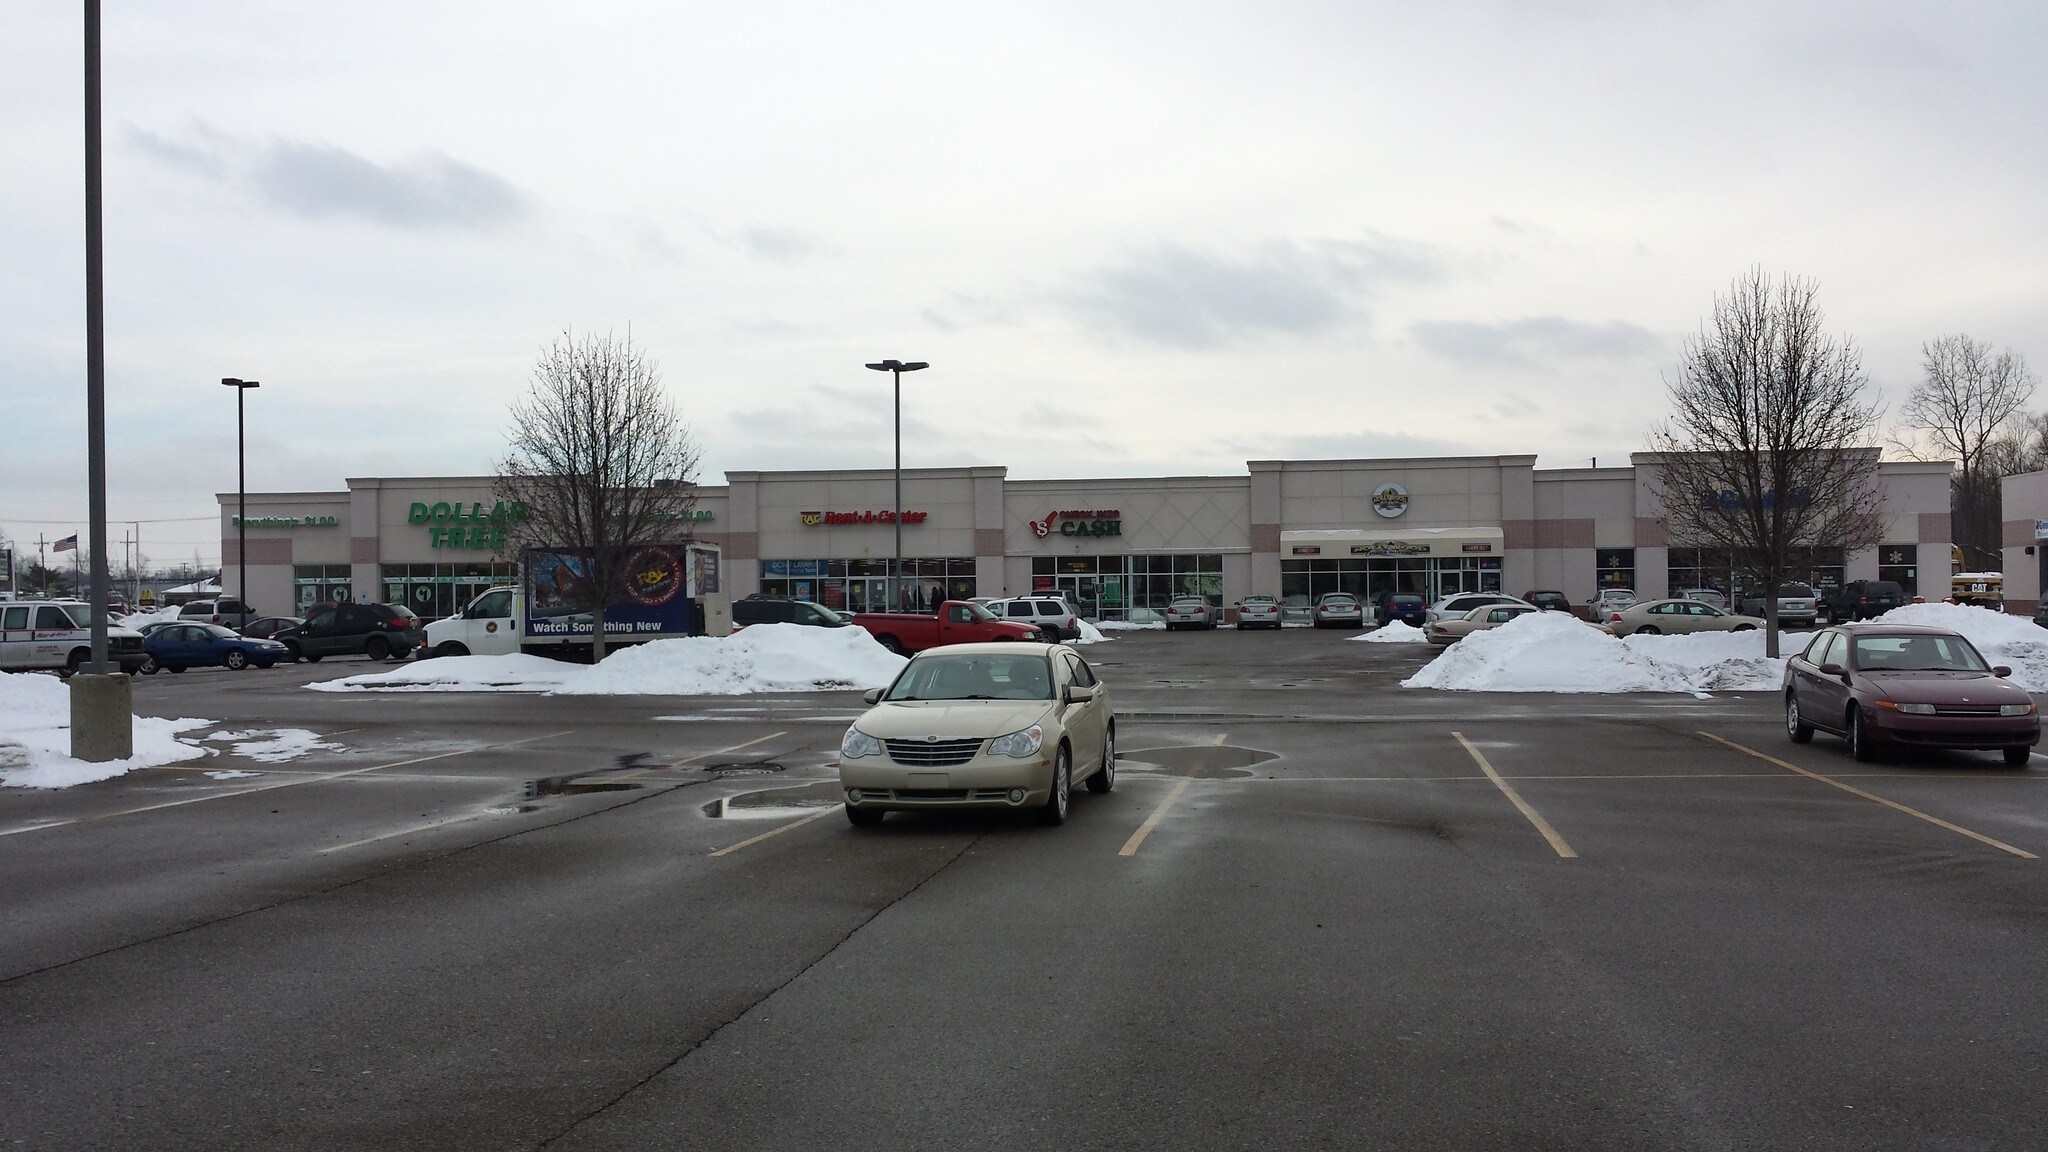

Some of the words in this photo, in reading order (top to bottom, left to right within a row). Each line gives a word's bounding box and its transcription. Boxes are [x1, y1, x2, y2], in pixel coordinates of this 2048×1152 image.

[408, 501, 531, 523] DOLLAR
[1059, 510, 1093, 519] CHECK
[1096, 510, 1120, 519] INTO
[801, 515, 821, 525] RAC
[428, 527, 506, 549] TREE
[1971, 583, 1988, 593] CAT
[533, 622, 569, 633] Watch
[572, 621, 633, 633] Somthing
[636, 620, 662, 631] New
